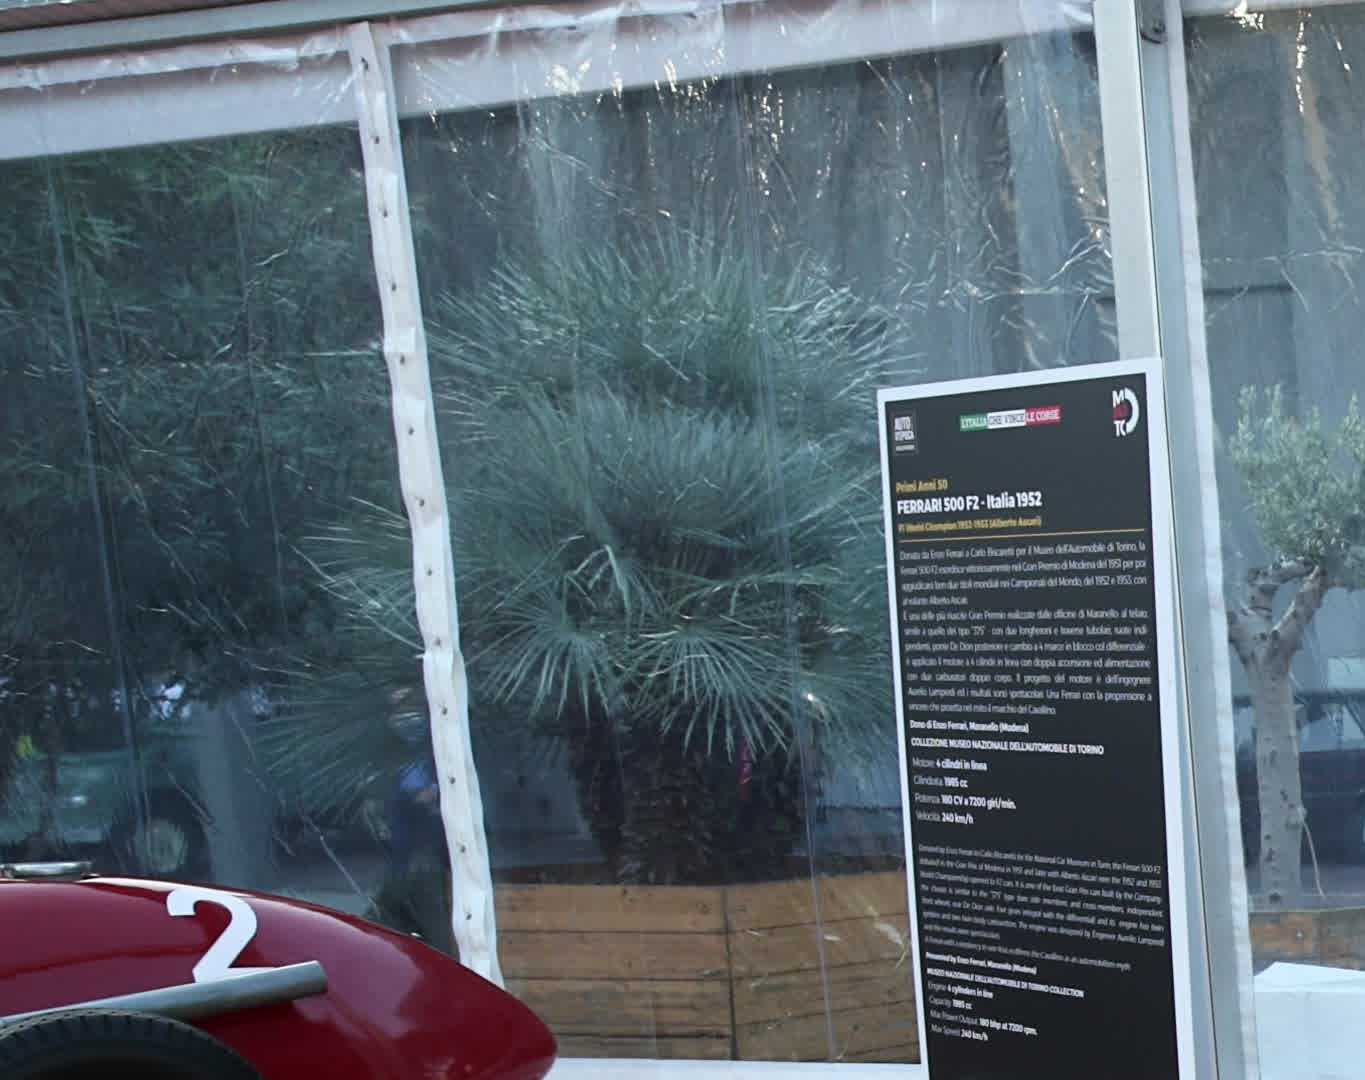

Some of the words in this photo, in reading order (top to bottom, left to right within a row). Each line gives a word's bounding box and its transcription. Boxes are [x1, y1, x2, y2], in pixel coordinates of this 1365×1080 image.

[897, 499, 942, 514] FERRARI
[944, 496, 965, 512] 500
[966, 495, 980, 511] F2
[986, 492, 1015, 510] Italia
[1016, 491, 1043, 507] 1952
[911, 738, 948, 748] COLLEZIONE
[949, 739, 971, 749] MUSEO
[972, 740, 1009, 750] NAZIONALE
[1069, 744, 1076, 753] DI
[1077, 745, 1104, 755] TORINO
[954, 796, 963, 805] CV
[955, 813, 974, 824] km/h
[167, 886, 278, 983] 2
